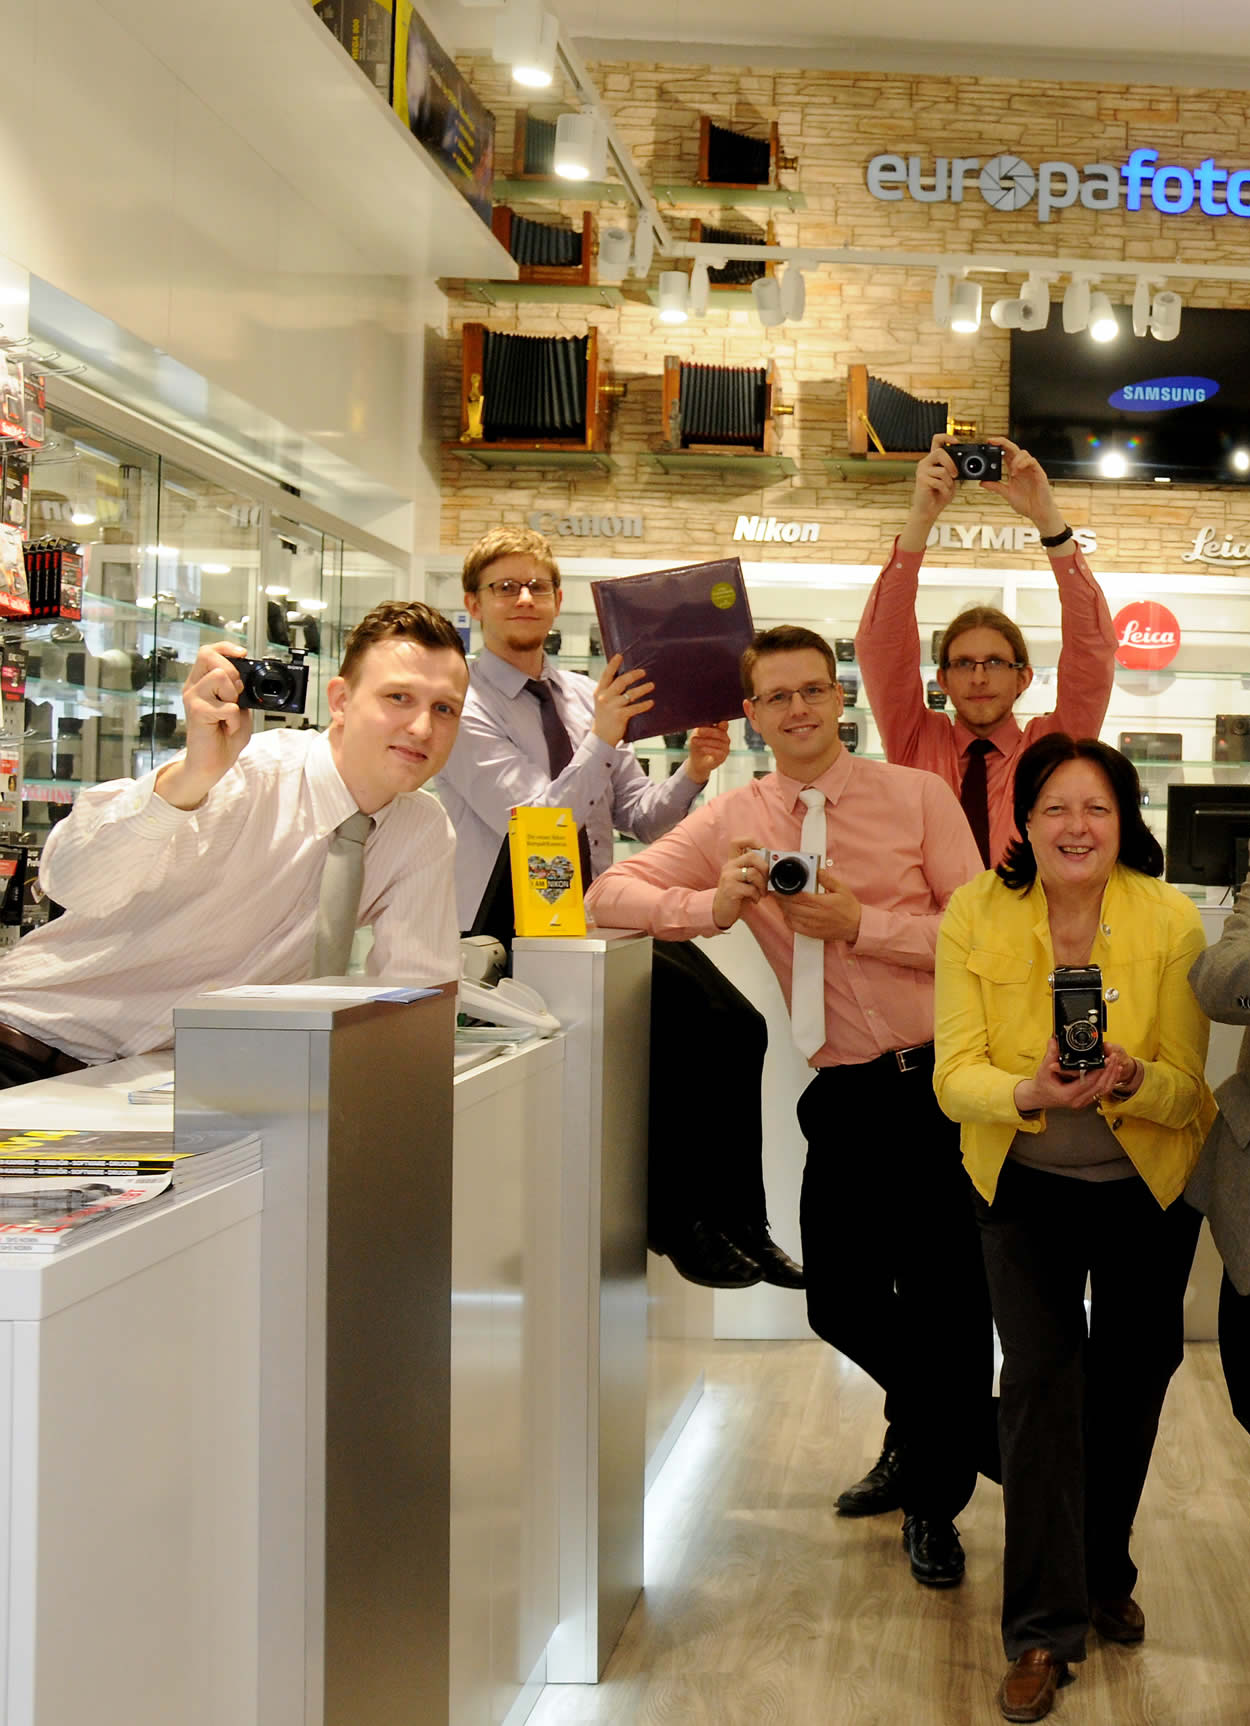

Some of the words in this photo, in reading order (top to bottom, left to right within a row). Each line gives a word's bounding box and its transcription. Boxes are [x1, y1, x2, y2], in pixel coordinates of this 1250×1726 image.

[1123, 385, 1206, 403] SAMSUNG
[528, 511, 643, 538] Canon
[733, 515, 821, 543] Nikon
[925, 524, 1097, 554] OLYMPS
[1118, 620, 1177, 649] Leica
